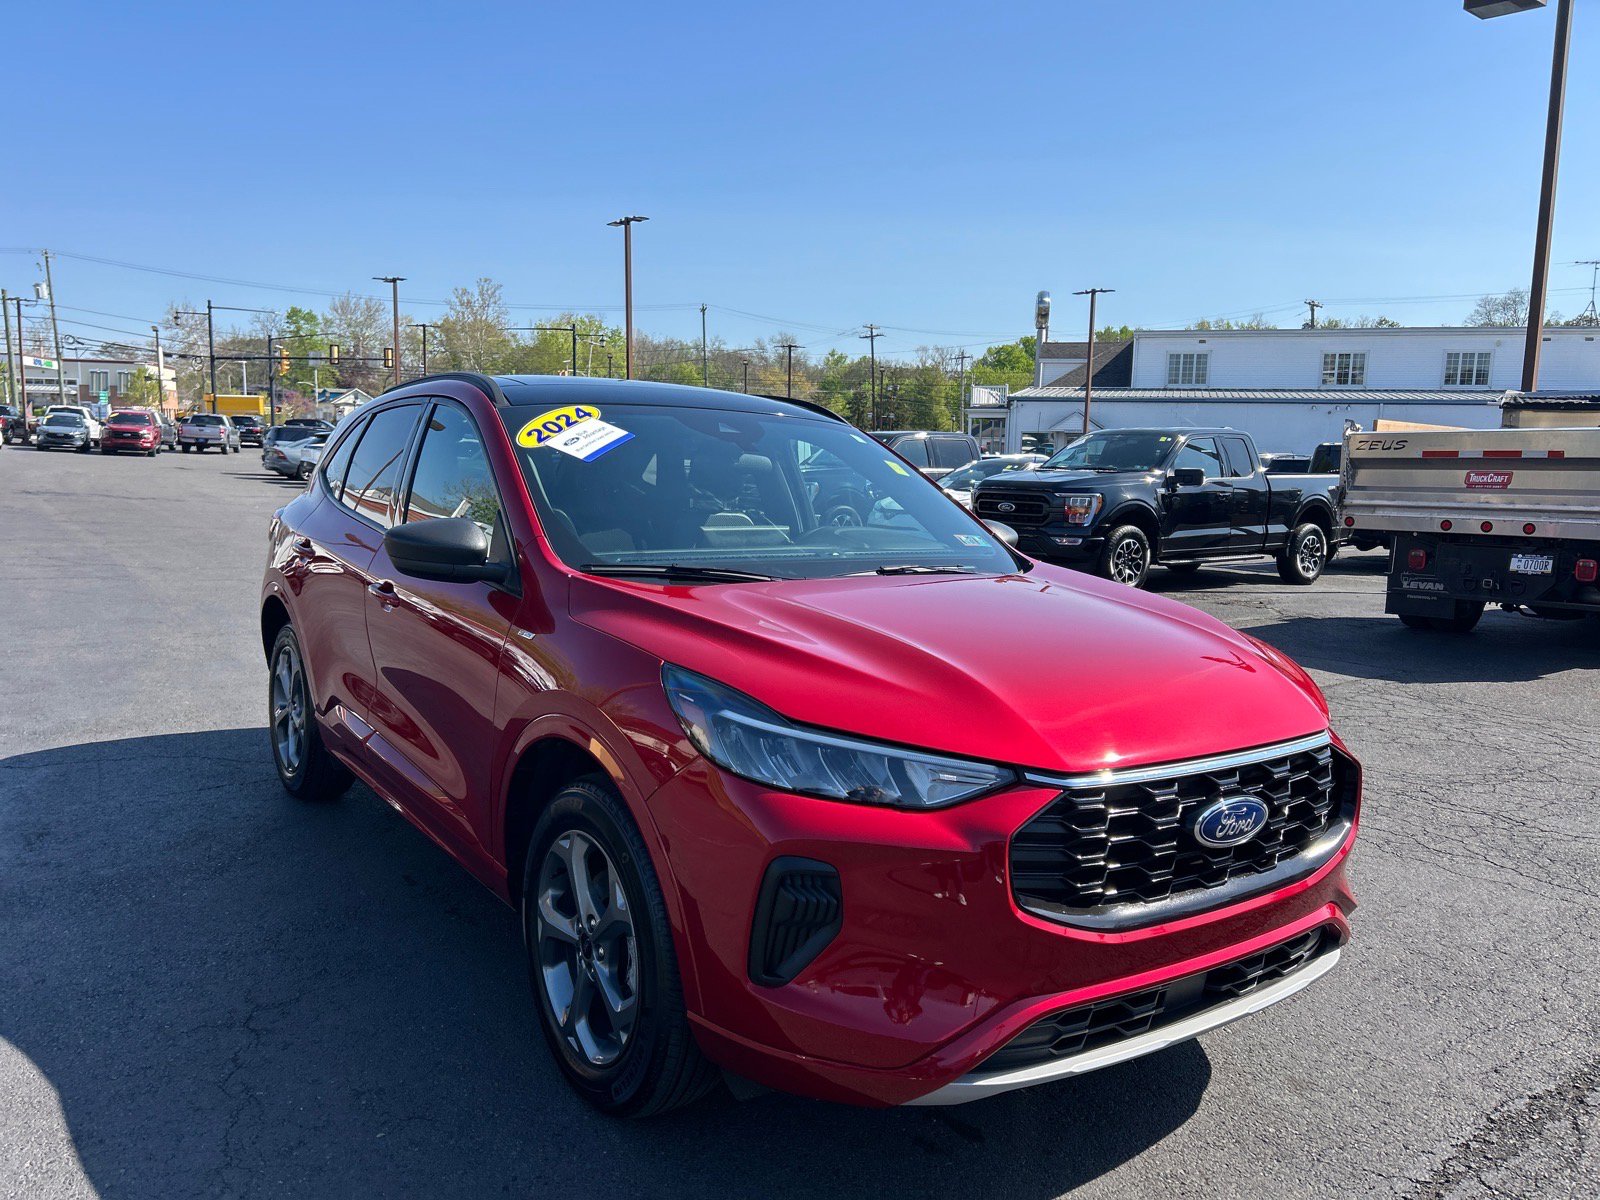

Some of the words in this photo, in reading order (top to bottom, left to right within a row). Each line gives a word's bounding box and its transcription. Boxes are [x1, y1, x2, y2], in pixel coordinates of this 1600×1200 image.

[526, 407, 592, 443] 2024
[1355, 440, 1408, 450] ZEUS
[1523, 559, 1550, 571] 0700R
[1402, 581, 1444, 591] LEVAN
[1216, 807, 1256, 838] Ford
